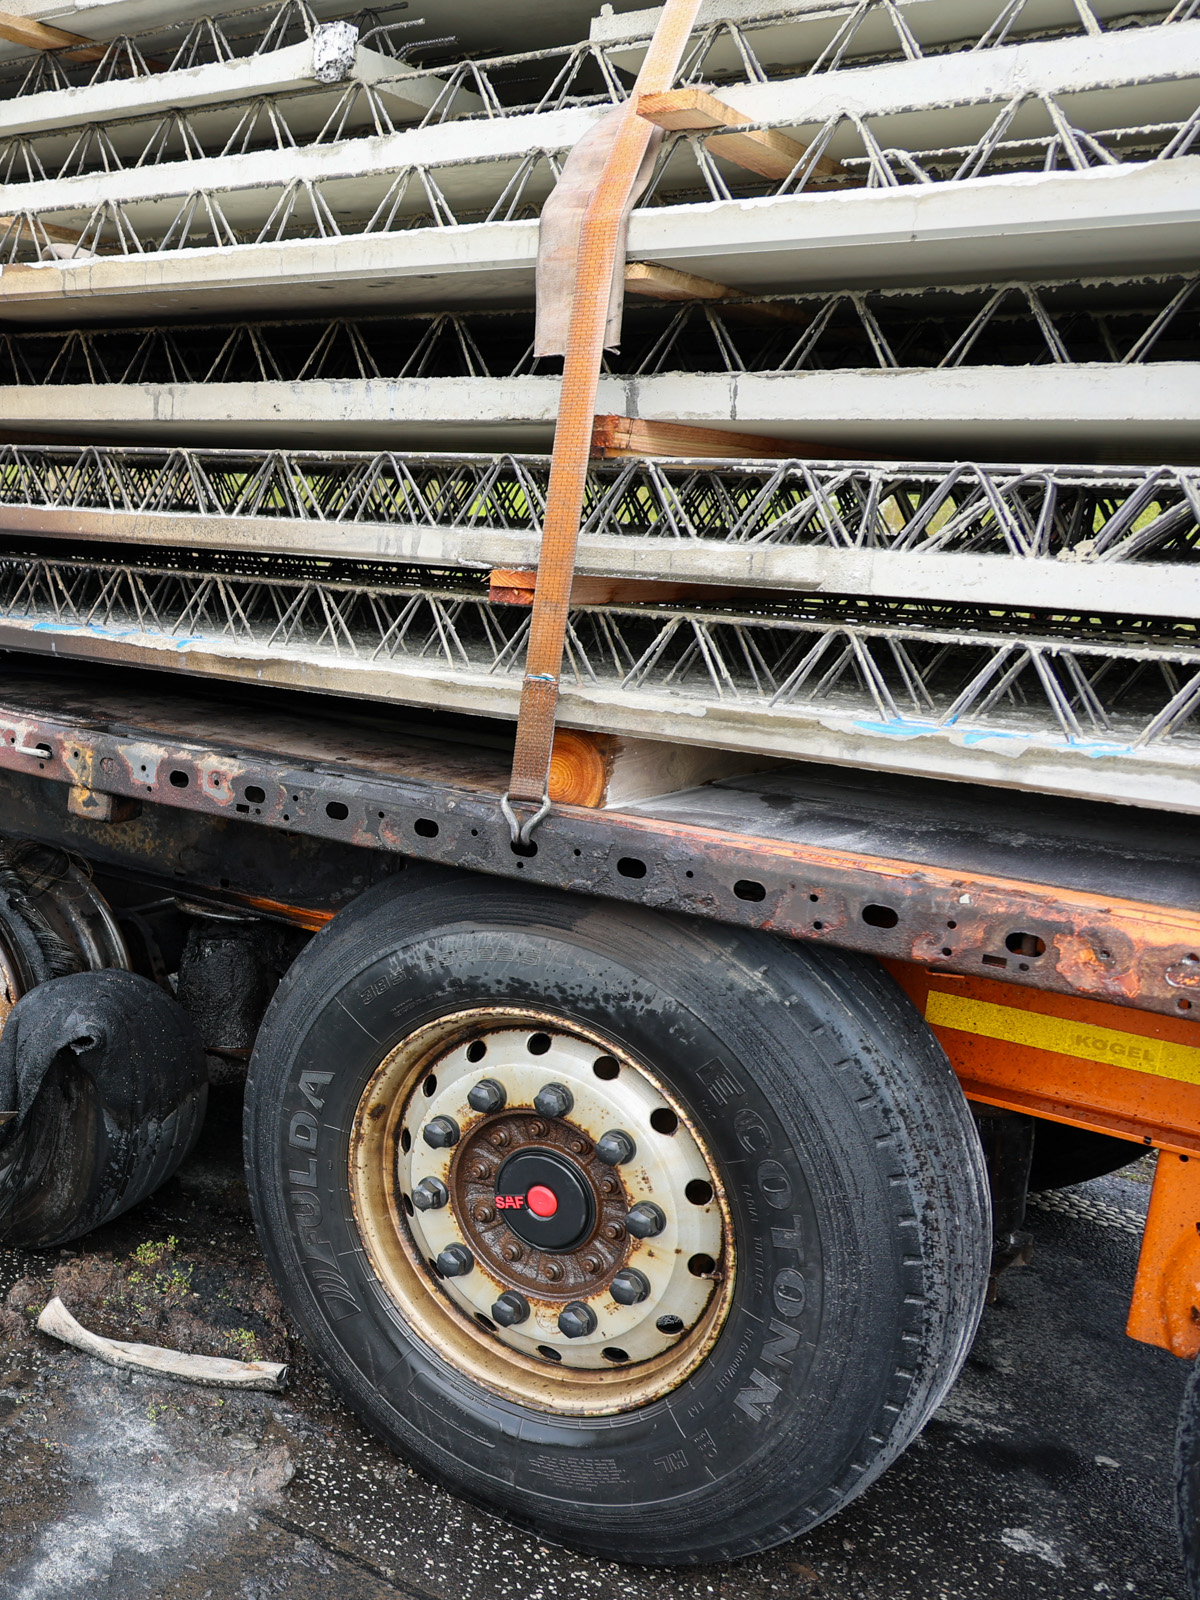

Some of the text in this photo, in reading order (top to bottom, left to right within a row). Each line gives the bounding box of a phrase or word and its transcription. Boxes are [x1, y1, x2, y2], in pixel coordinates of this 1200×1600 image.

[1075, 1034, 1155, 1062] KÖGEL
[288, 1070, 341, 1273] FULDA
[494, 1195, 524, 1209] SAF
